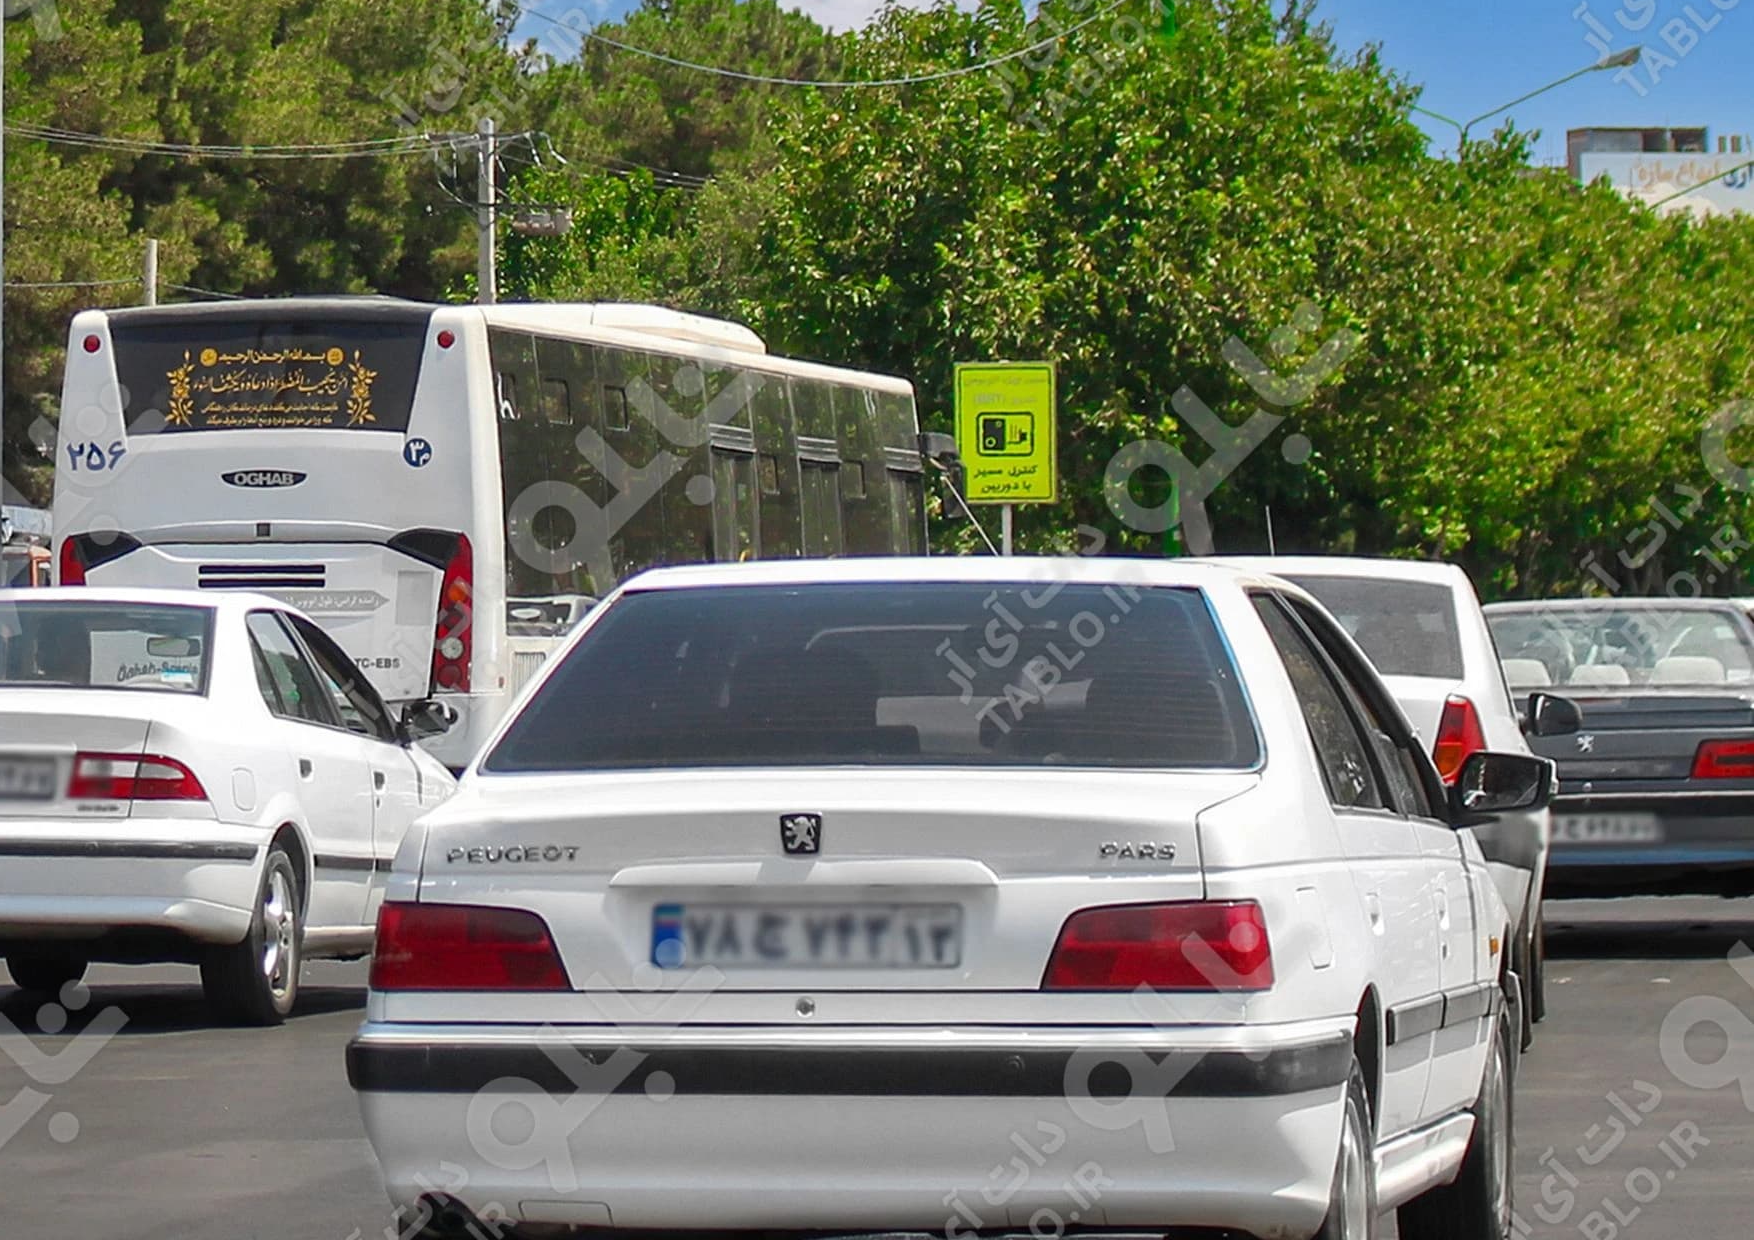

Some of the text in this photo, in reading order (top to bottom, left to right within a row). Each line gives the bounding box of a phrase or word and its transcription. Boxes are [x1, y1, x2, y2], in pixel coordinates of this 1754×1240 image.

[66, 440, 127, 472] ۲۵۶
[1007, 464, 1038, 477] کنترل
[233, 472, 294, 487] OGHAB
[1022, 480, 1032, 492] با
[446, 845, 581, 864] PEUGEOT
[1100, 842, 1176, 861] PARS
